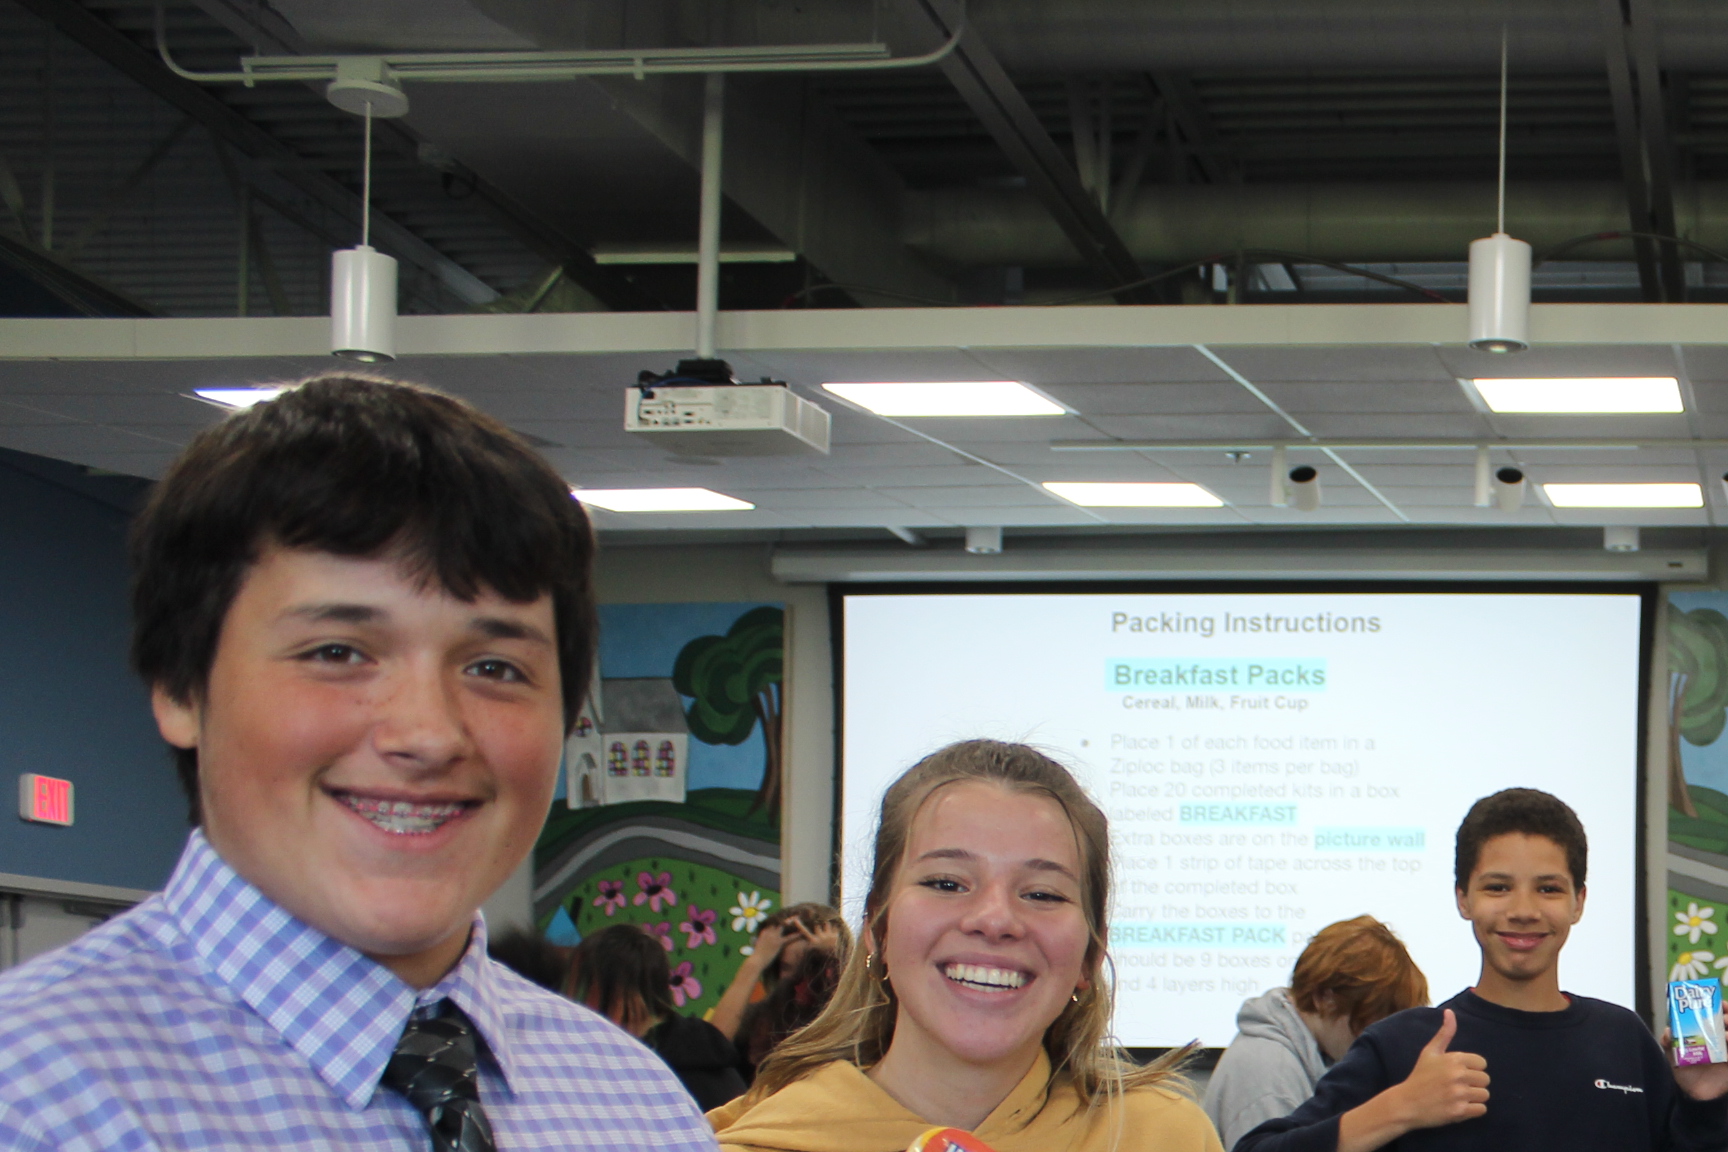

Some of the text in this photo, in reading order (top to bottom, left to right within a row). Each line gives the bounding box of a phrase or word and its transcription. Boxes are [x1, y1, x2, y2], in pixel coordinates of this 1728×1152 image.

[1111, 611, 1381, 637] Packing Instructions
[1114, 664, 1326, 685] Breakfast Packs
[1122, 696, 1309, 712] Cereal, Milk, Fruit Cup
[1110, 734, 1375, 750] Place 1 of each food item in a
[1110, 759, 1360, 777] Ziploc bag (3 items per bag)
[34, 775, 70, 822] EXIT
[1110, 783, 1399, 800] Place 20 completed kits in a box
[1180, 807, 1297, 822] BREAKFAST
[1160, 831, 1213, 846] boxes
[1219, 834, 1246, 846] are
[1252, 834, 1274, 846] on
[1280, 831, 1308, 846] the
[1315, 831, 1380, 850] picture
[1387, 831, 1424, 847] wall
[1166, 855, 1421, 874] 1 strip of tape across the top
[1131, 879, 1298, 898] the completed box
[1162, 904, 1189, 918] the
[1196, 904, 1249, 918] boxes
[1255, 905, 1272, 918] to
[1279, 904, 1306, 918] the
[1110, 927, 1225, 942] BREAKFAST
[1232, 927, 1285, 943] PACK
[1173, 952, 1271, 968] be 9 boxes
[1147, 976, 1259, 996] 4 layers high
[1674, 985, 1716, 1000] Dairy
[1679, 999, 1715, 1014] Pure
[1594, 1078, 1643, 1095] Champion
